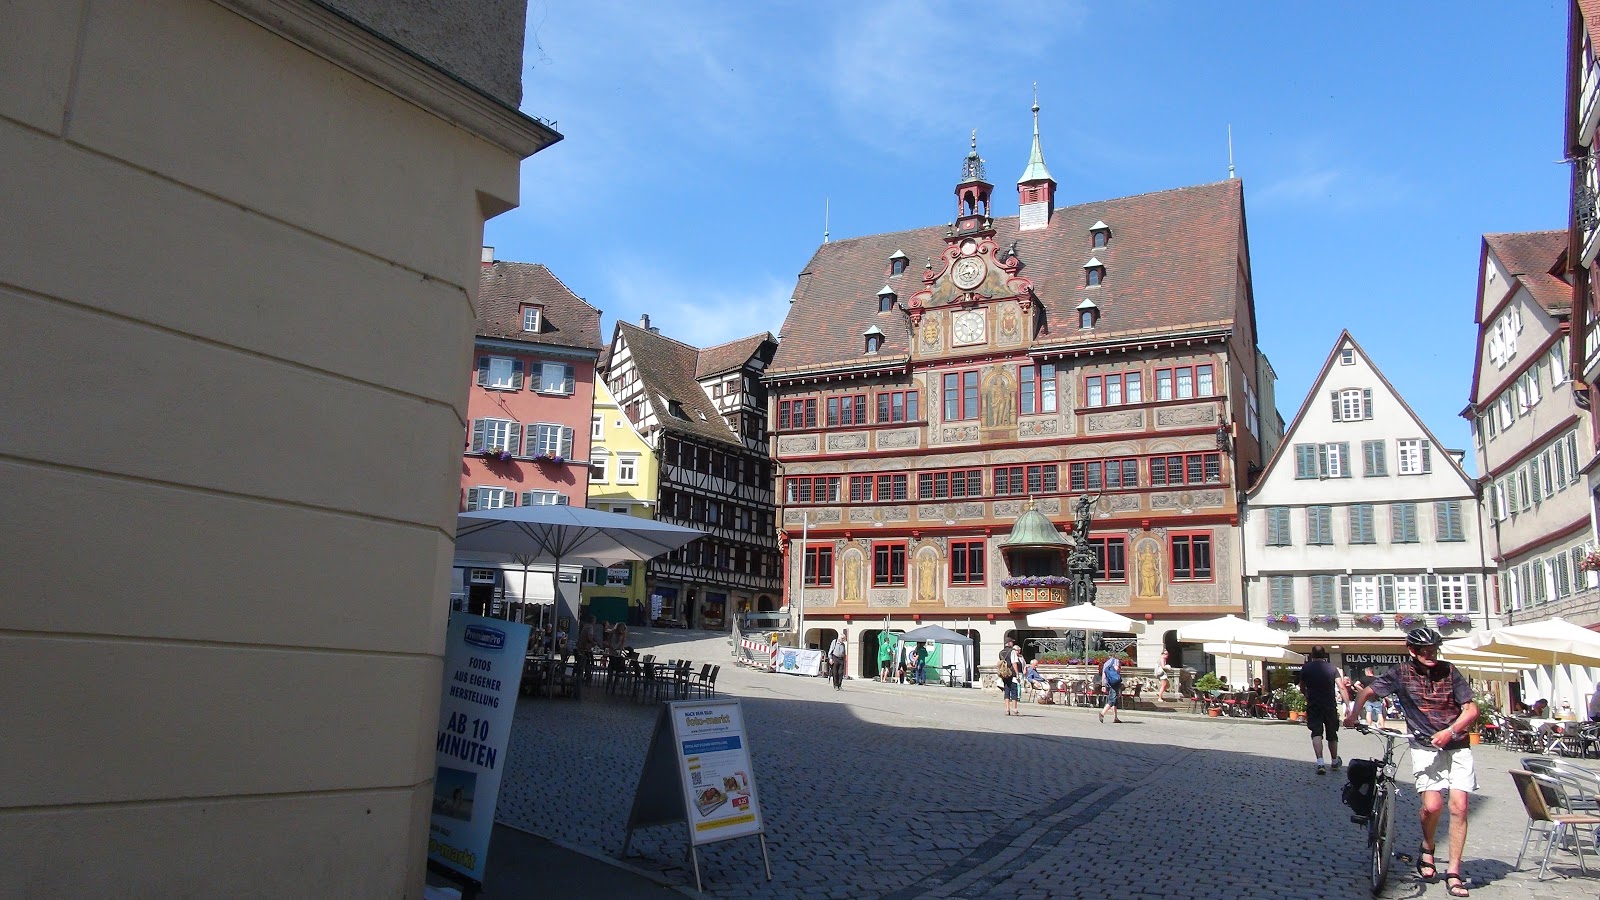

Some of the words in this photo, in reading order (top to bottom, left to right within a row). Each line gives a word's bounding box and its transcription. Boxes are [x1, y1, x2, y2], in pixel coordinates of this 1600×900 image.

[469, 657, 492, 672] FOTOS
[454, 670, 468, 684] AUS
[469, 674, 501, 691] EIGENER
[450, 685, 499, 708] HERSTELLUNG
[447, 711, 468, 734] AB
[473, 718, 489, 741] 10
[686, 714, 731, 726] foto-markt
[437, 731, 497, 770] MINUTEN
[429, 834, 476, 871] o-markt
